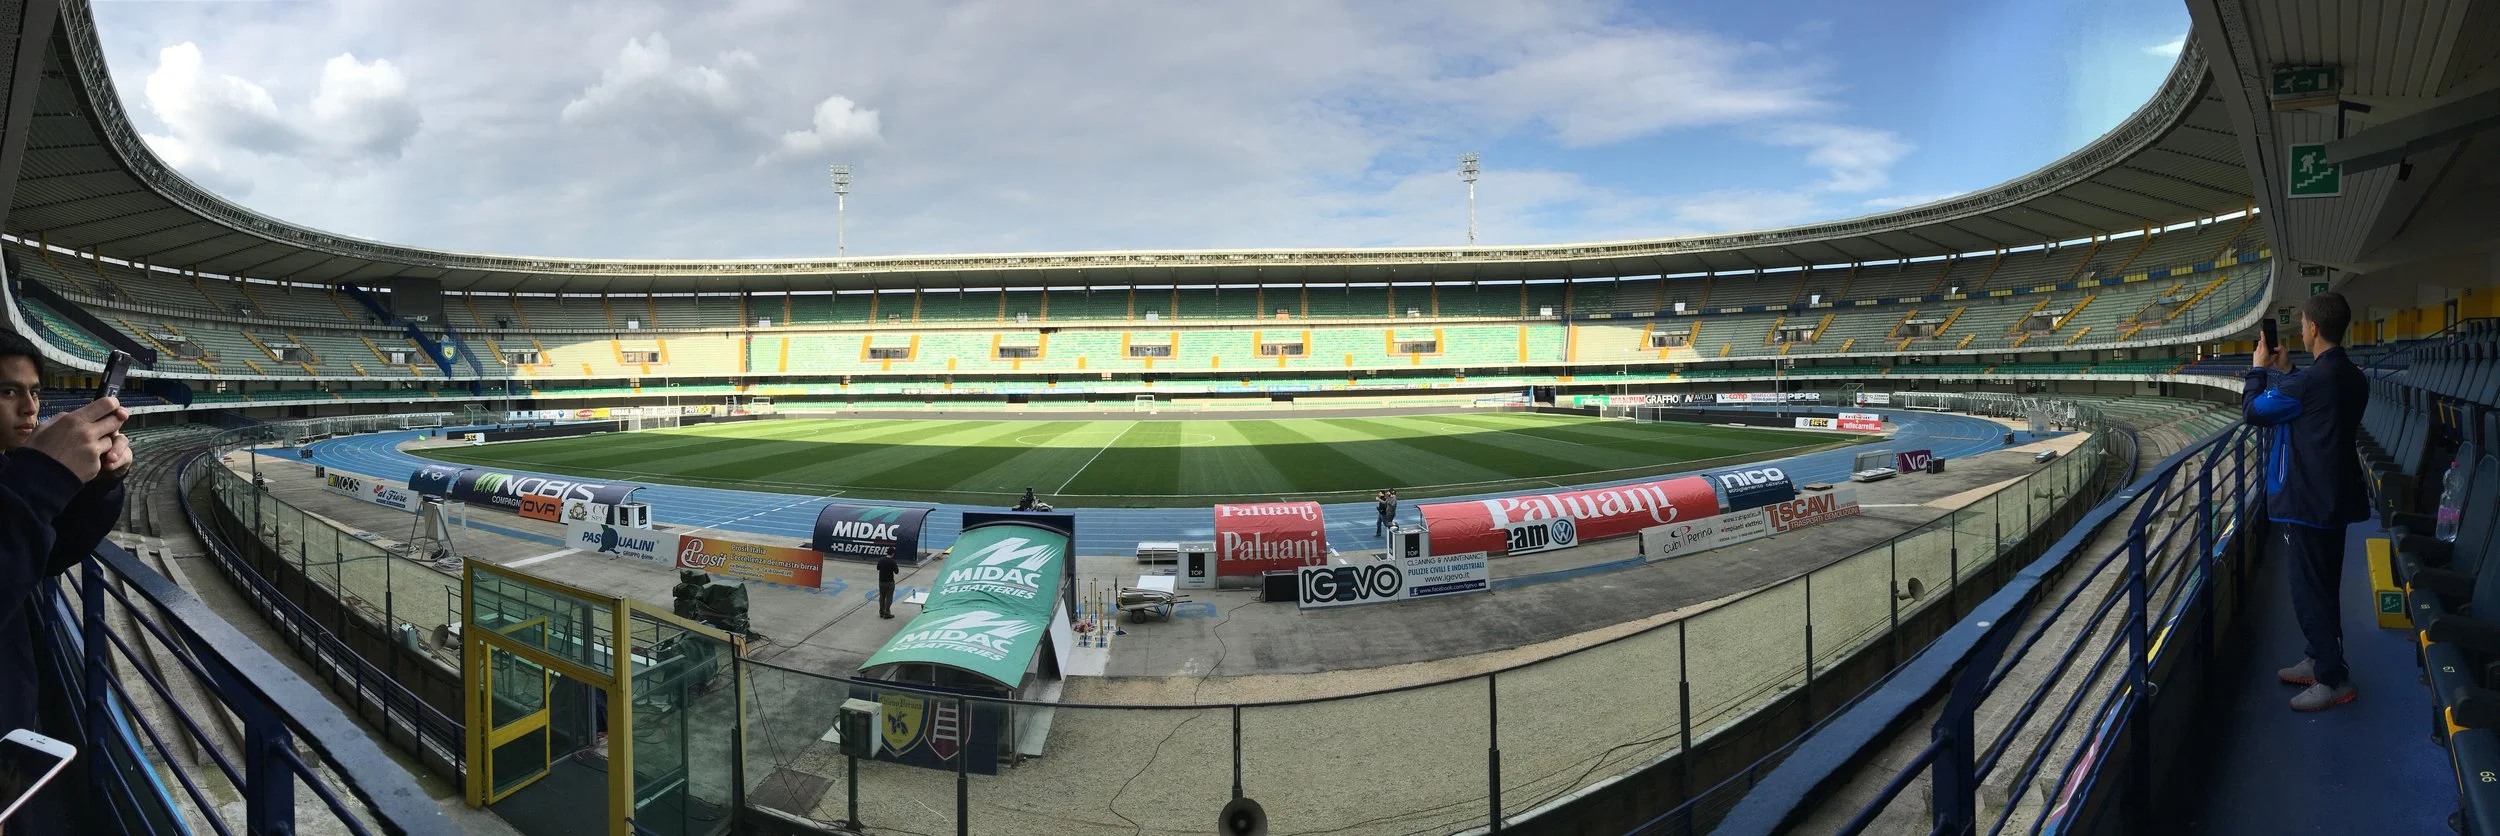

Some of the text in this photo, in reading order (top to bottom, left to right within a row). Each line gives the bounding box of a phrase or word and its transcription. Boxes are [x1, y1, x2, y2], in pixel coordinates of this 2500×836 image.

[1646, 394, 1679, 404] GRAFFIO
[494, 474, 604, 502] NOBIS
[1719, 467, 1784, 490] nico
[1728, 480, 1789, 494] abbigliamento calzature
[492, 495, 522, 508] COMPAGN
[1482, 482, 1678, 531] Paluani
[1222, 504, 1317, 521] Paluani
[1790, 506, 1859, 528] TRASPORTI DEMOLIZIONI
[582, 524, 655, 554] PASQUALINI
[832, 520, 900, 540] MIDAC
[731, 544, 767, 554] Prosit Italia
[1222, 530, 1322, 566] Paluani
[1663, 540, 1682, 554] Cubi
[1687, 527, 1713, 544] Perina
[680, 538, 727, 568] Prosit
[1406, 558, 1436, 566] CLEANING
[1444, 552, 1484, 562] MAINTENANCE
[767, 558, 778, 566] dei
[778, 560, 800, 568] mastri
[800, 563, 819, 572] birrai
[1408, 567, 1428, 576] PULIZIE
[1430, 566, 1446, 574] CIVILI
[1452, 562, 1484, 571] INDUSTRIALI
[944, 566, 1042, 589] MIDAC
[1302, 564, 1403, 604] IGEVO
[960, 584, 1037, 600] BATTERIES
[894, 630, 1014, 654] MIDAC
[910, 642, 1005, 661] BATTERIES
[2480, 771, 2497, 783] 66
